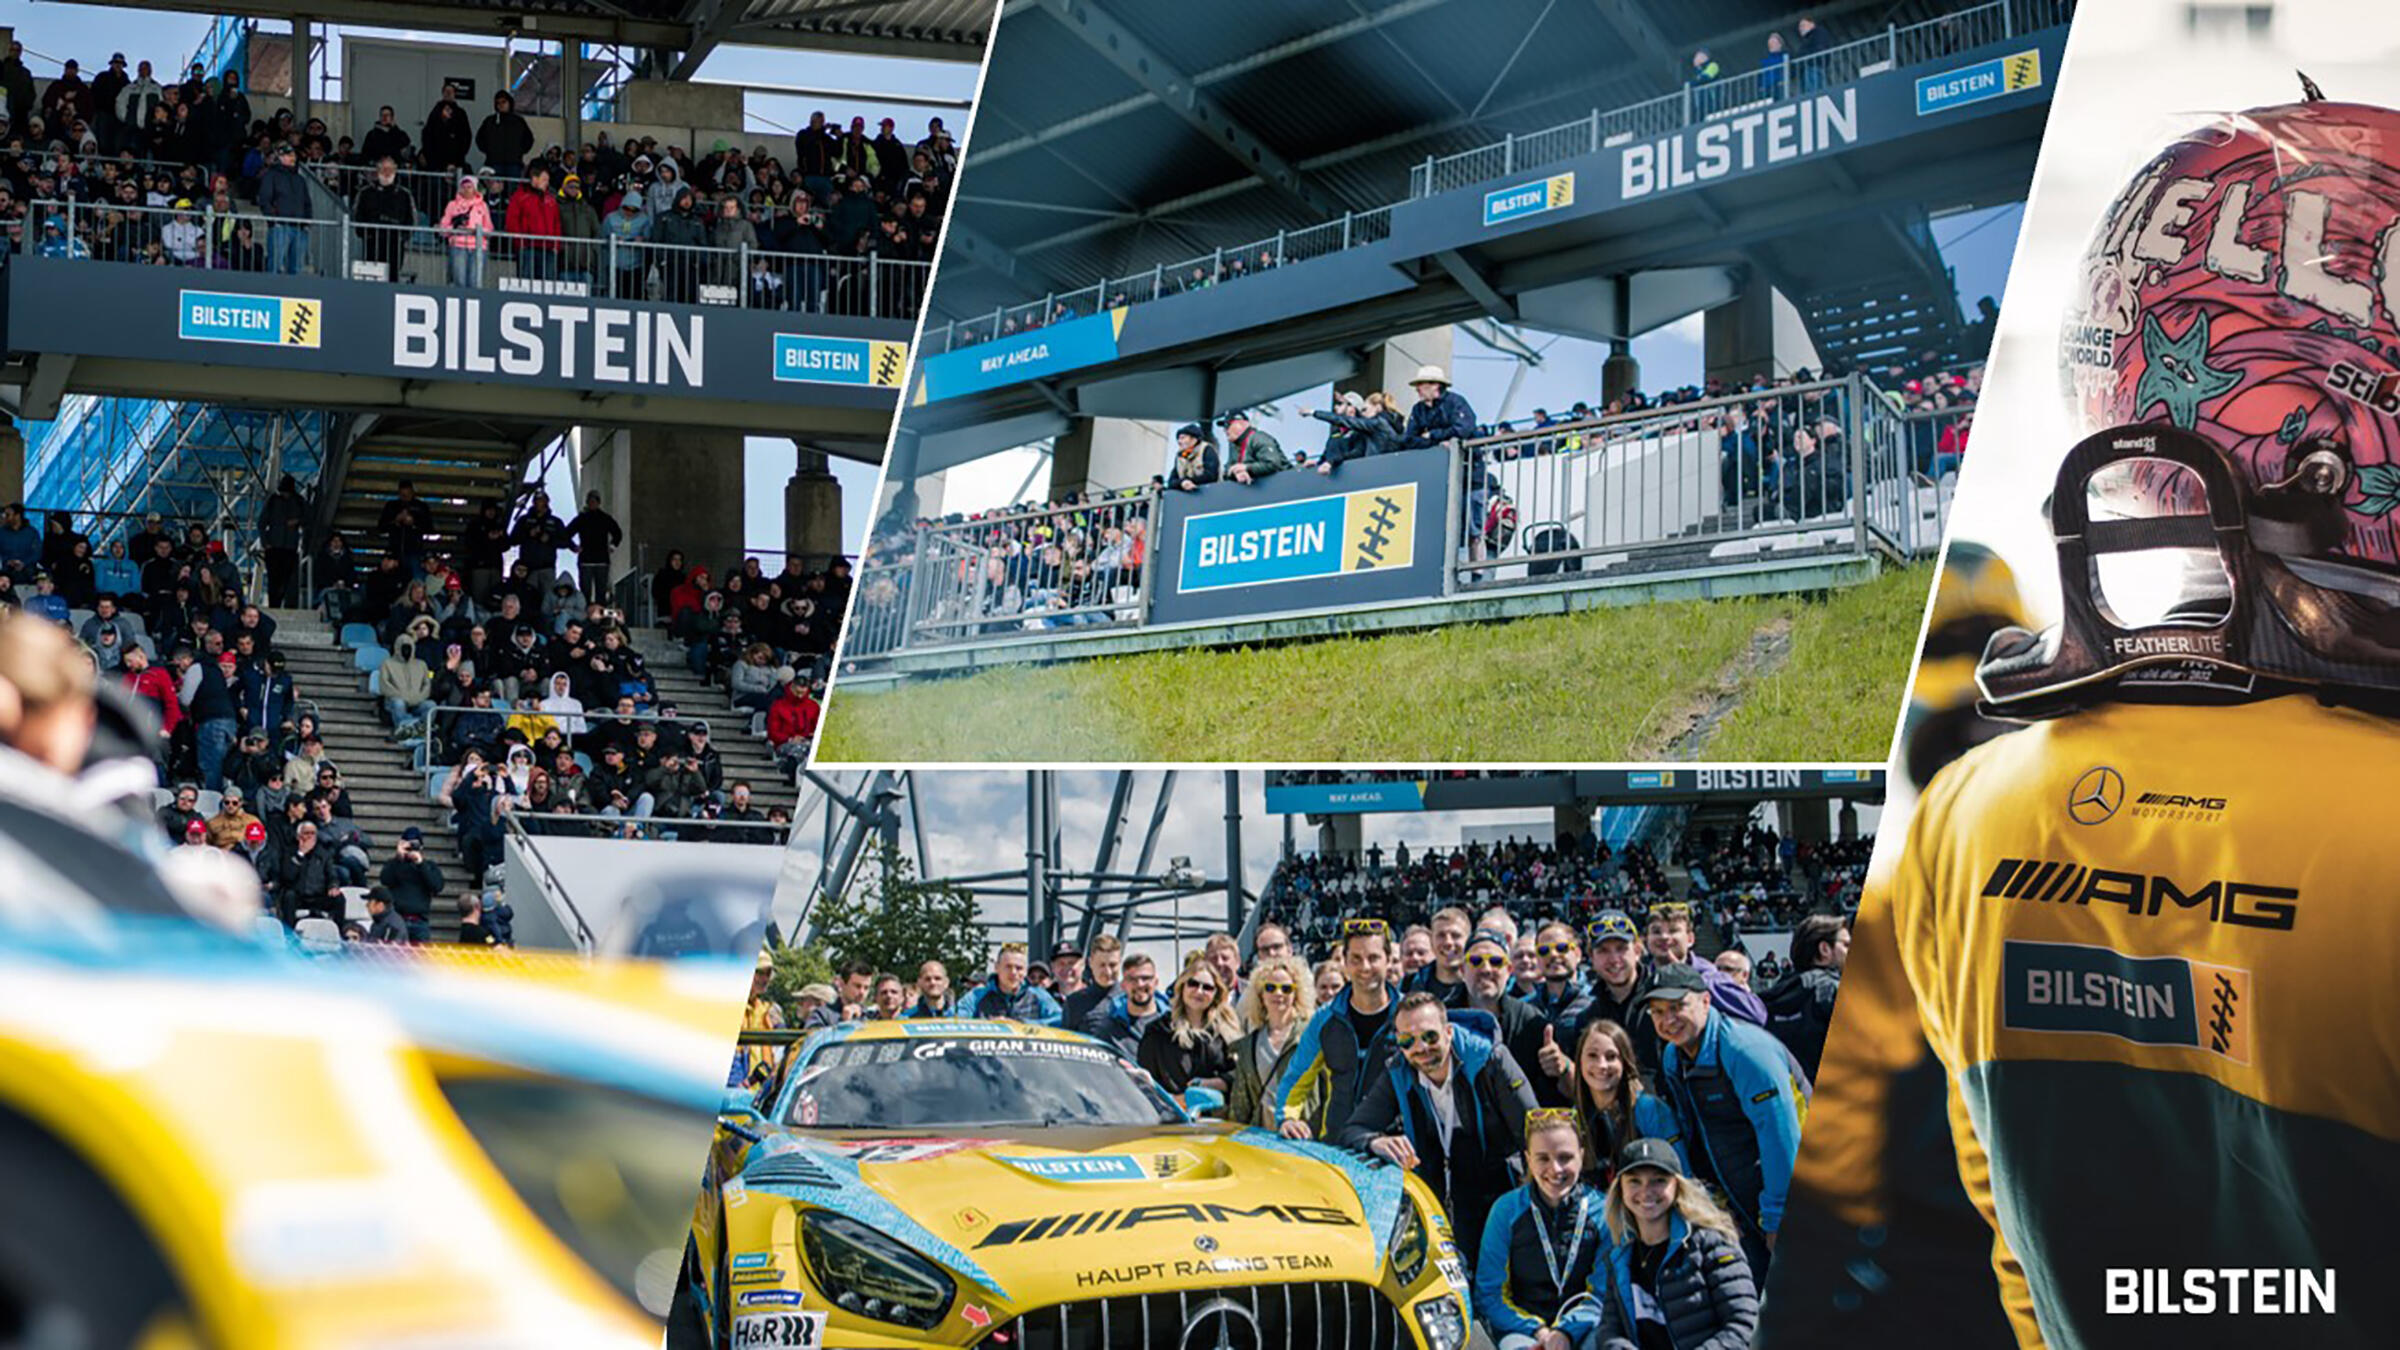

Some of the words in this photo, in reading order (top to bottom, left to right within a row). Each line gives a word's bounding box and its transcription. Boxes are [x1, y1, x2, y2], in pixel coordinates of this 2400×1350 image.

[1926, 72, 1995, 102] BILSTEIN
[1621, 88, 1857, 199] BILSTEIN
[1492, 190, 1541, 214] BILSTEIN
[192, 305, 270, 330] BILSTEIN
[393, 293, 704, 387] BILSTEIN
[785, 348, 860, 372] BILSTEIN
[1199, 521, 1325, 567] BILSTEIN
[2114, 635, 2221, 654] FEATHERLITE
[1697, 770, 1801, 790] BILSTEIN
[2131, 807, 2223, 822] MOTORSPORT
[2165, 795, 2228, 810] AMG
[2076, 867, 2299, 931] AMG
[2026, 969, 2176, 1019] BILSTEIN
[969, 1040, 1023, 1051] GRAN
[1030, 1042, 1109, 1062] TURISMO
[1116, 1203, 1360, 1229] AMG
[1076, 1262, 1165, 1288] HAUPT
[1175, 1256, 1268, 1277] RACING
[1273, 1254, 1333, 1271] TEAM
[736, 1318, 778, 1346] H&R
